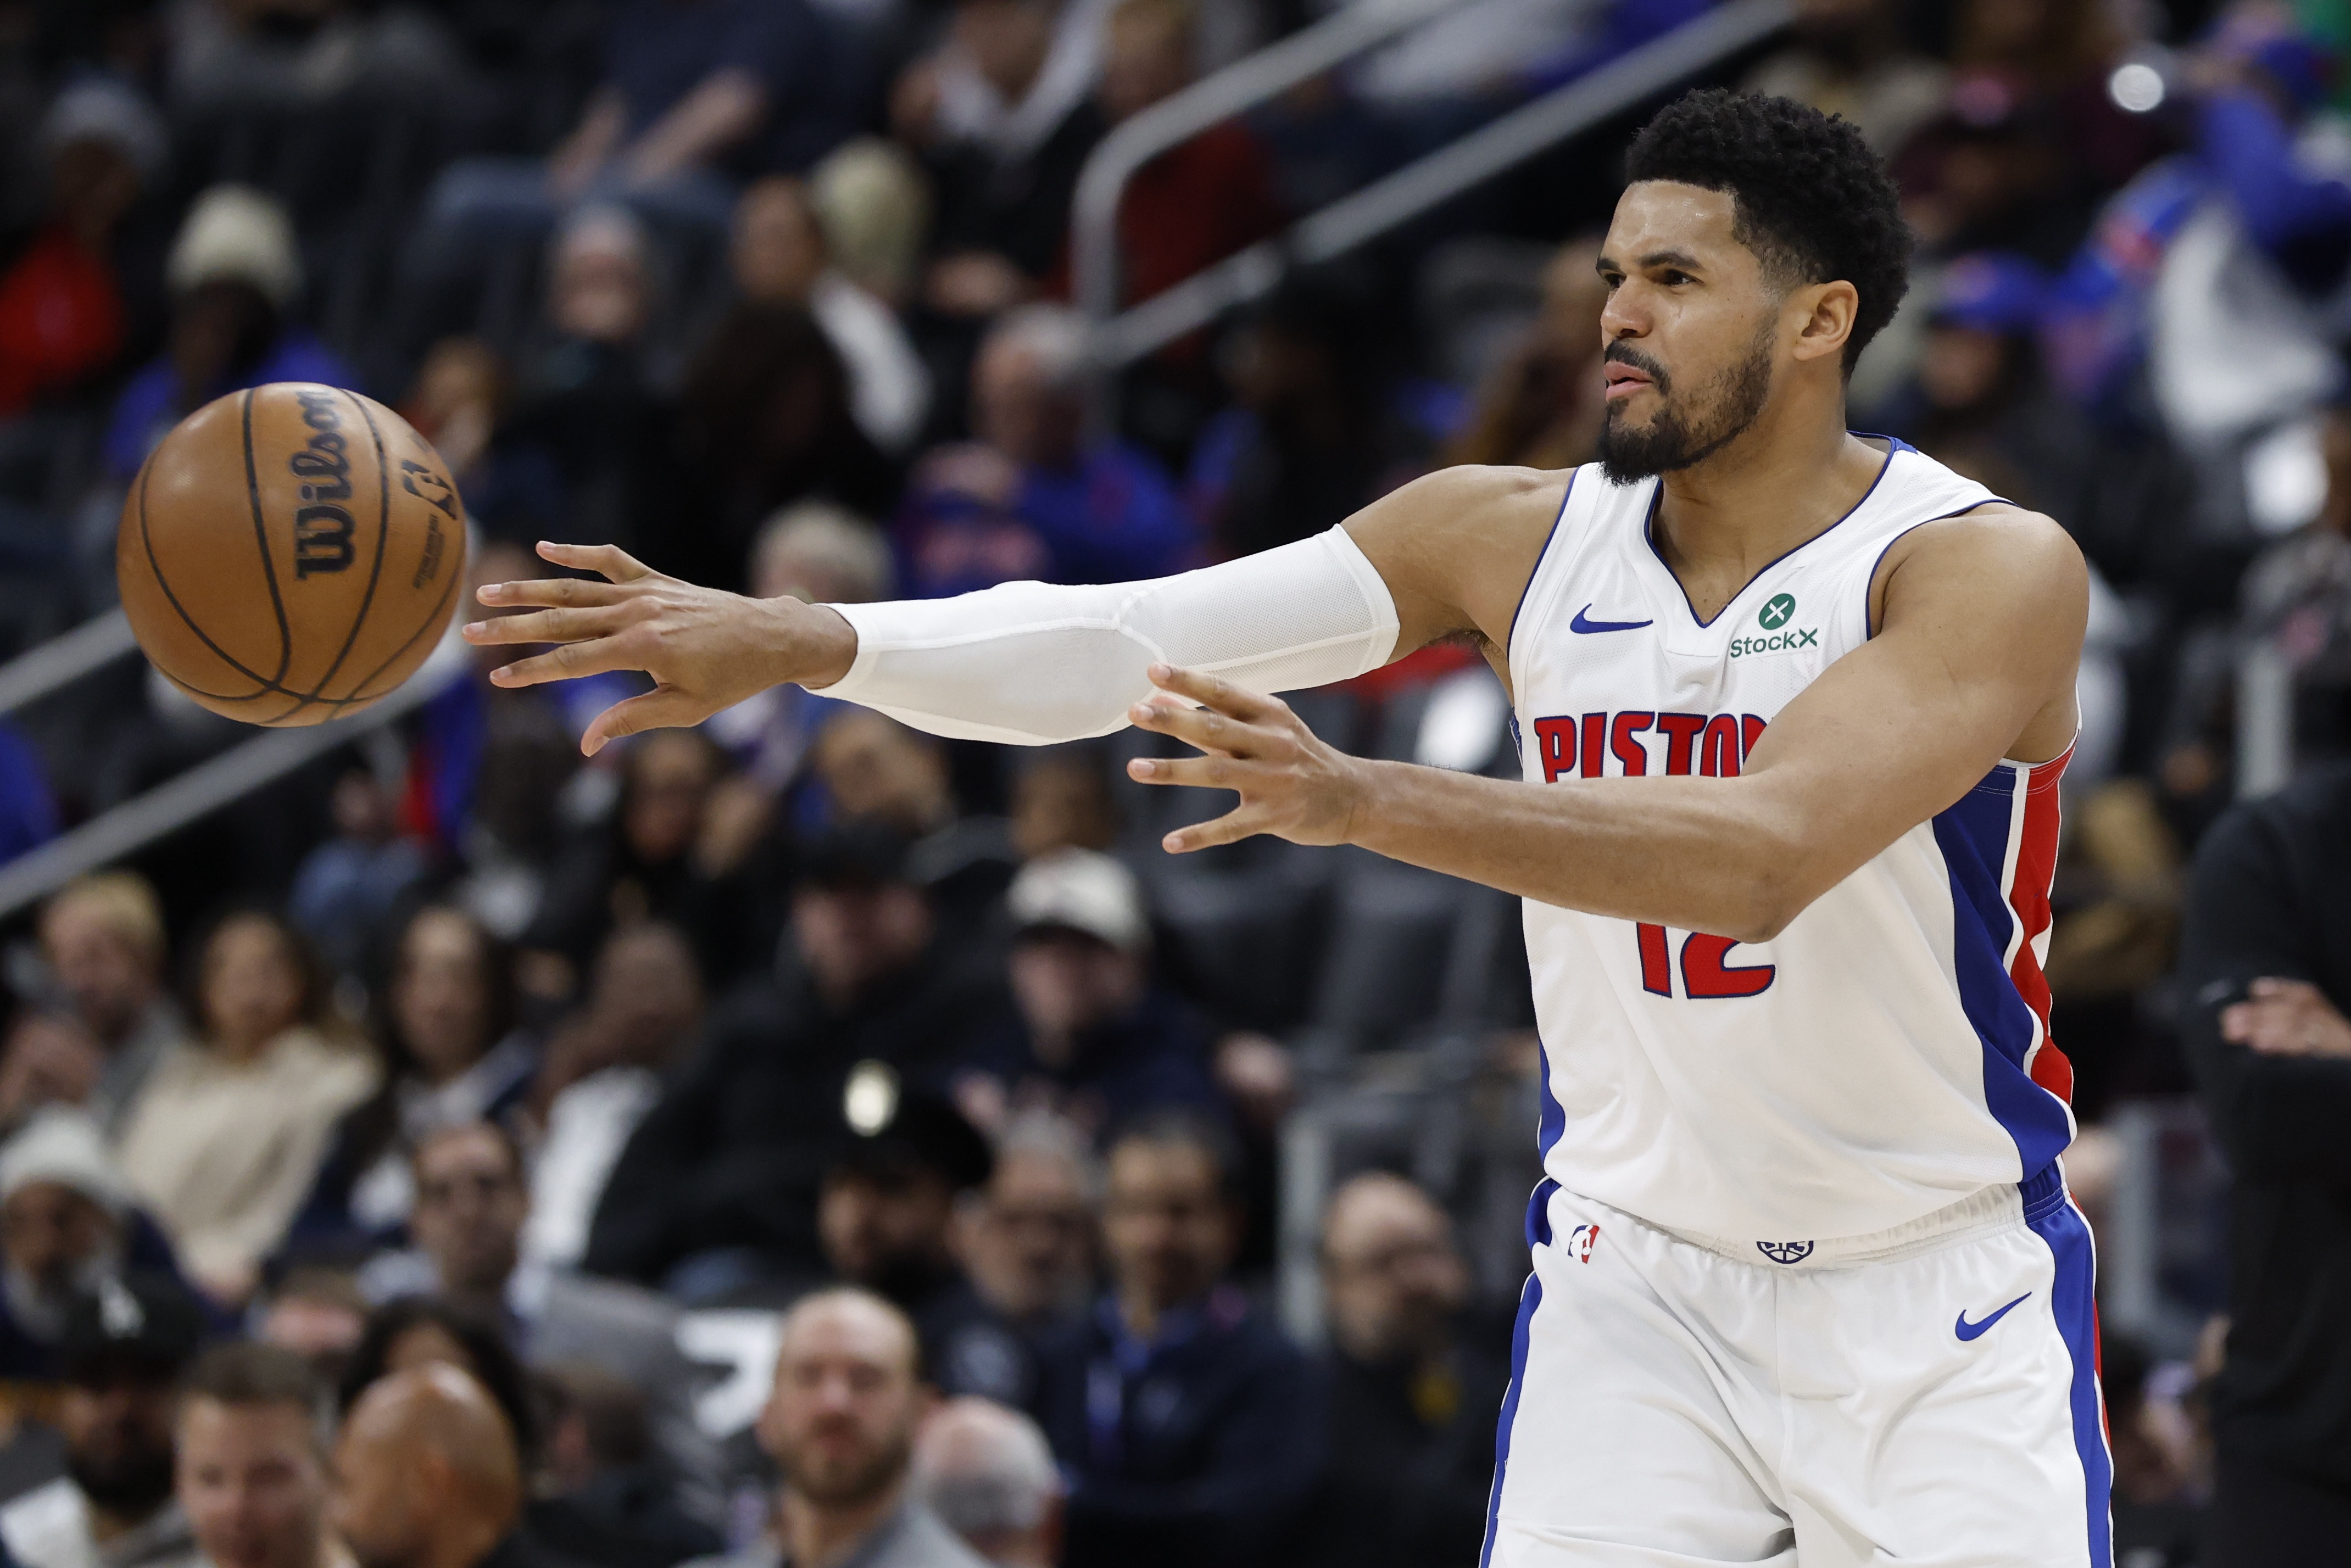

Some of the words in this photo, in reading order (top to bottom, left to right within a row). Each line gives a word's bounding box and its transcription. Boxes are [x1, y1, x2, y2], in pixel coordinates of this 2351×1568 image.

[291, 392, 355, 580] Wilson
[1730, 628, 1818, 658] StockX
[1534, 711, 1768, 784] PISTO
